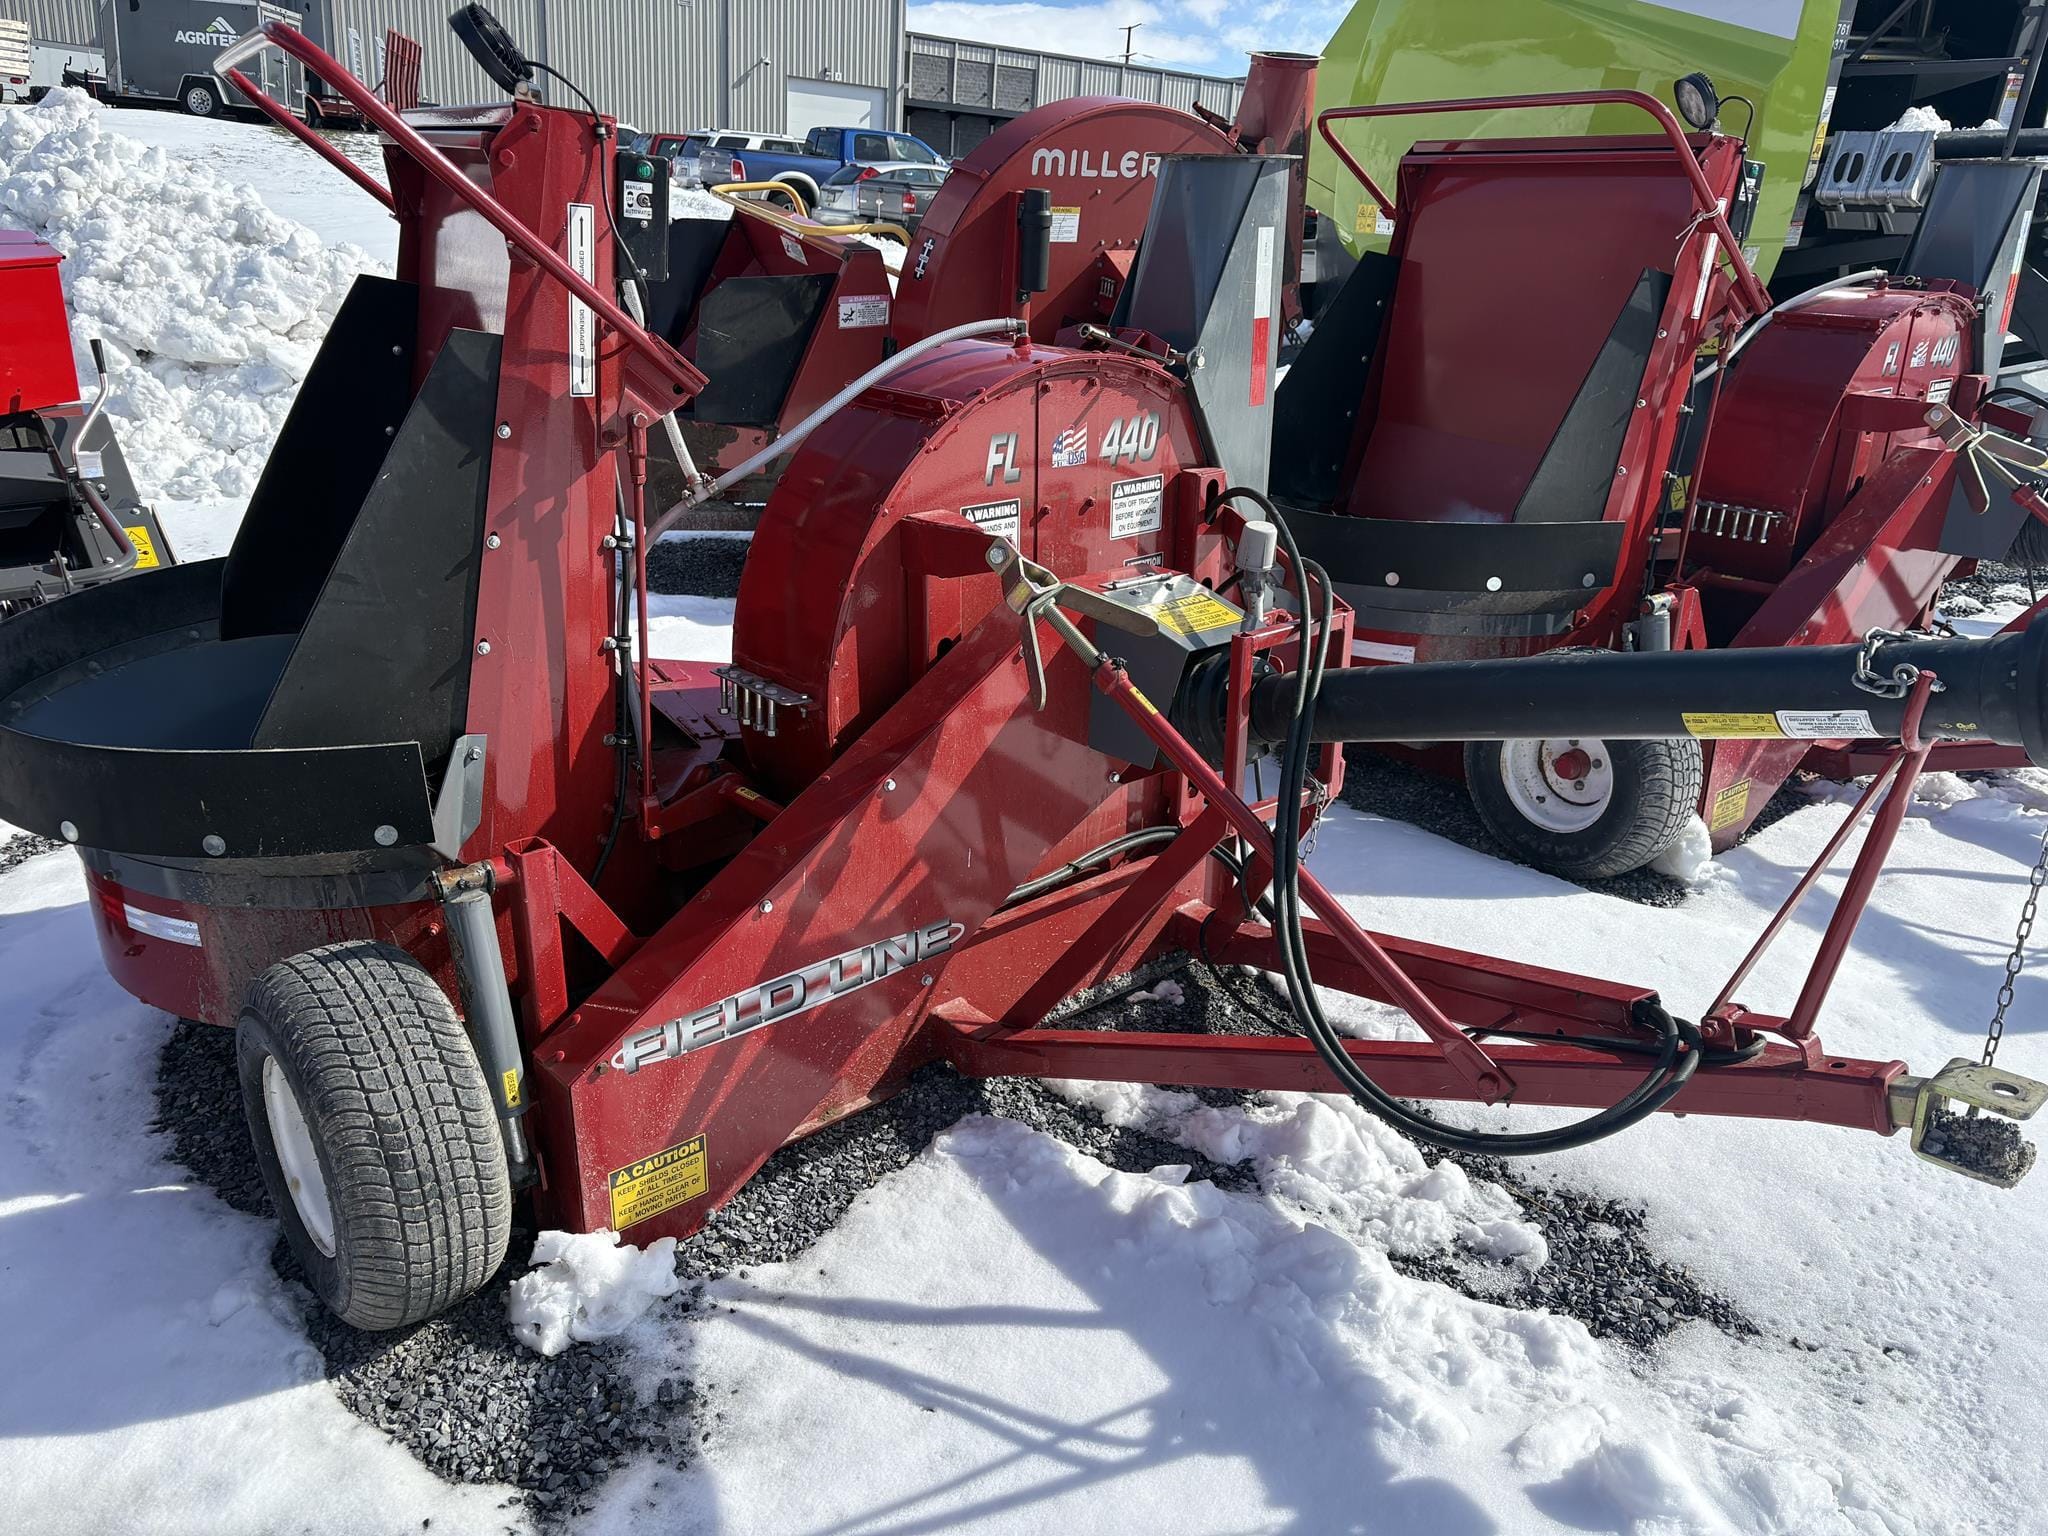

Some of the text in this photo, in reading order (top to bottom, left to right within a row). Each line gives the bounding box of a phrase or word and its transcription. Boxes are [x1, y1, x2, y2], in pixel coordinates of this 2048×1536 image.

[175, 30, 241, 47] AGRITEE
[1031, 148, 1161, 178] MILLER
[1881, 340, 1900, 378] FL
[1929, 332, 1960, 369] 440
[1099, 412, 1160, 467] 440
[984, 431, 1022, 486] FL
[1068, 449, 1087, 465] USA
[1122, 479, 1161, 496] WARNING
[974, 503, 1017, 521] WARNING
[1115, 495, 1159, 510] TURN OFF TRACTOR
[1115, 506, 1157, 521] BEFORE WORKING
[1004, 520, 1016, 530] AND
[1118, 518, 1153, 532] ON EQUIPMENT
[622, 916, 951, 1075] FIELD LINE
[632, 1140, 700, 1178] CAUTION
[617, 1156, 700, 1197] KEEP SHIELDS CLOSED
[647, 1181, 660, 1191] ALL
[662, 1171, 683, 1185] TIMES
[618, 1174, 702, 1217] KEEP HANDS CLEAR OF
[635, 1189, 687, 1218] MOVING PARTS
